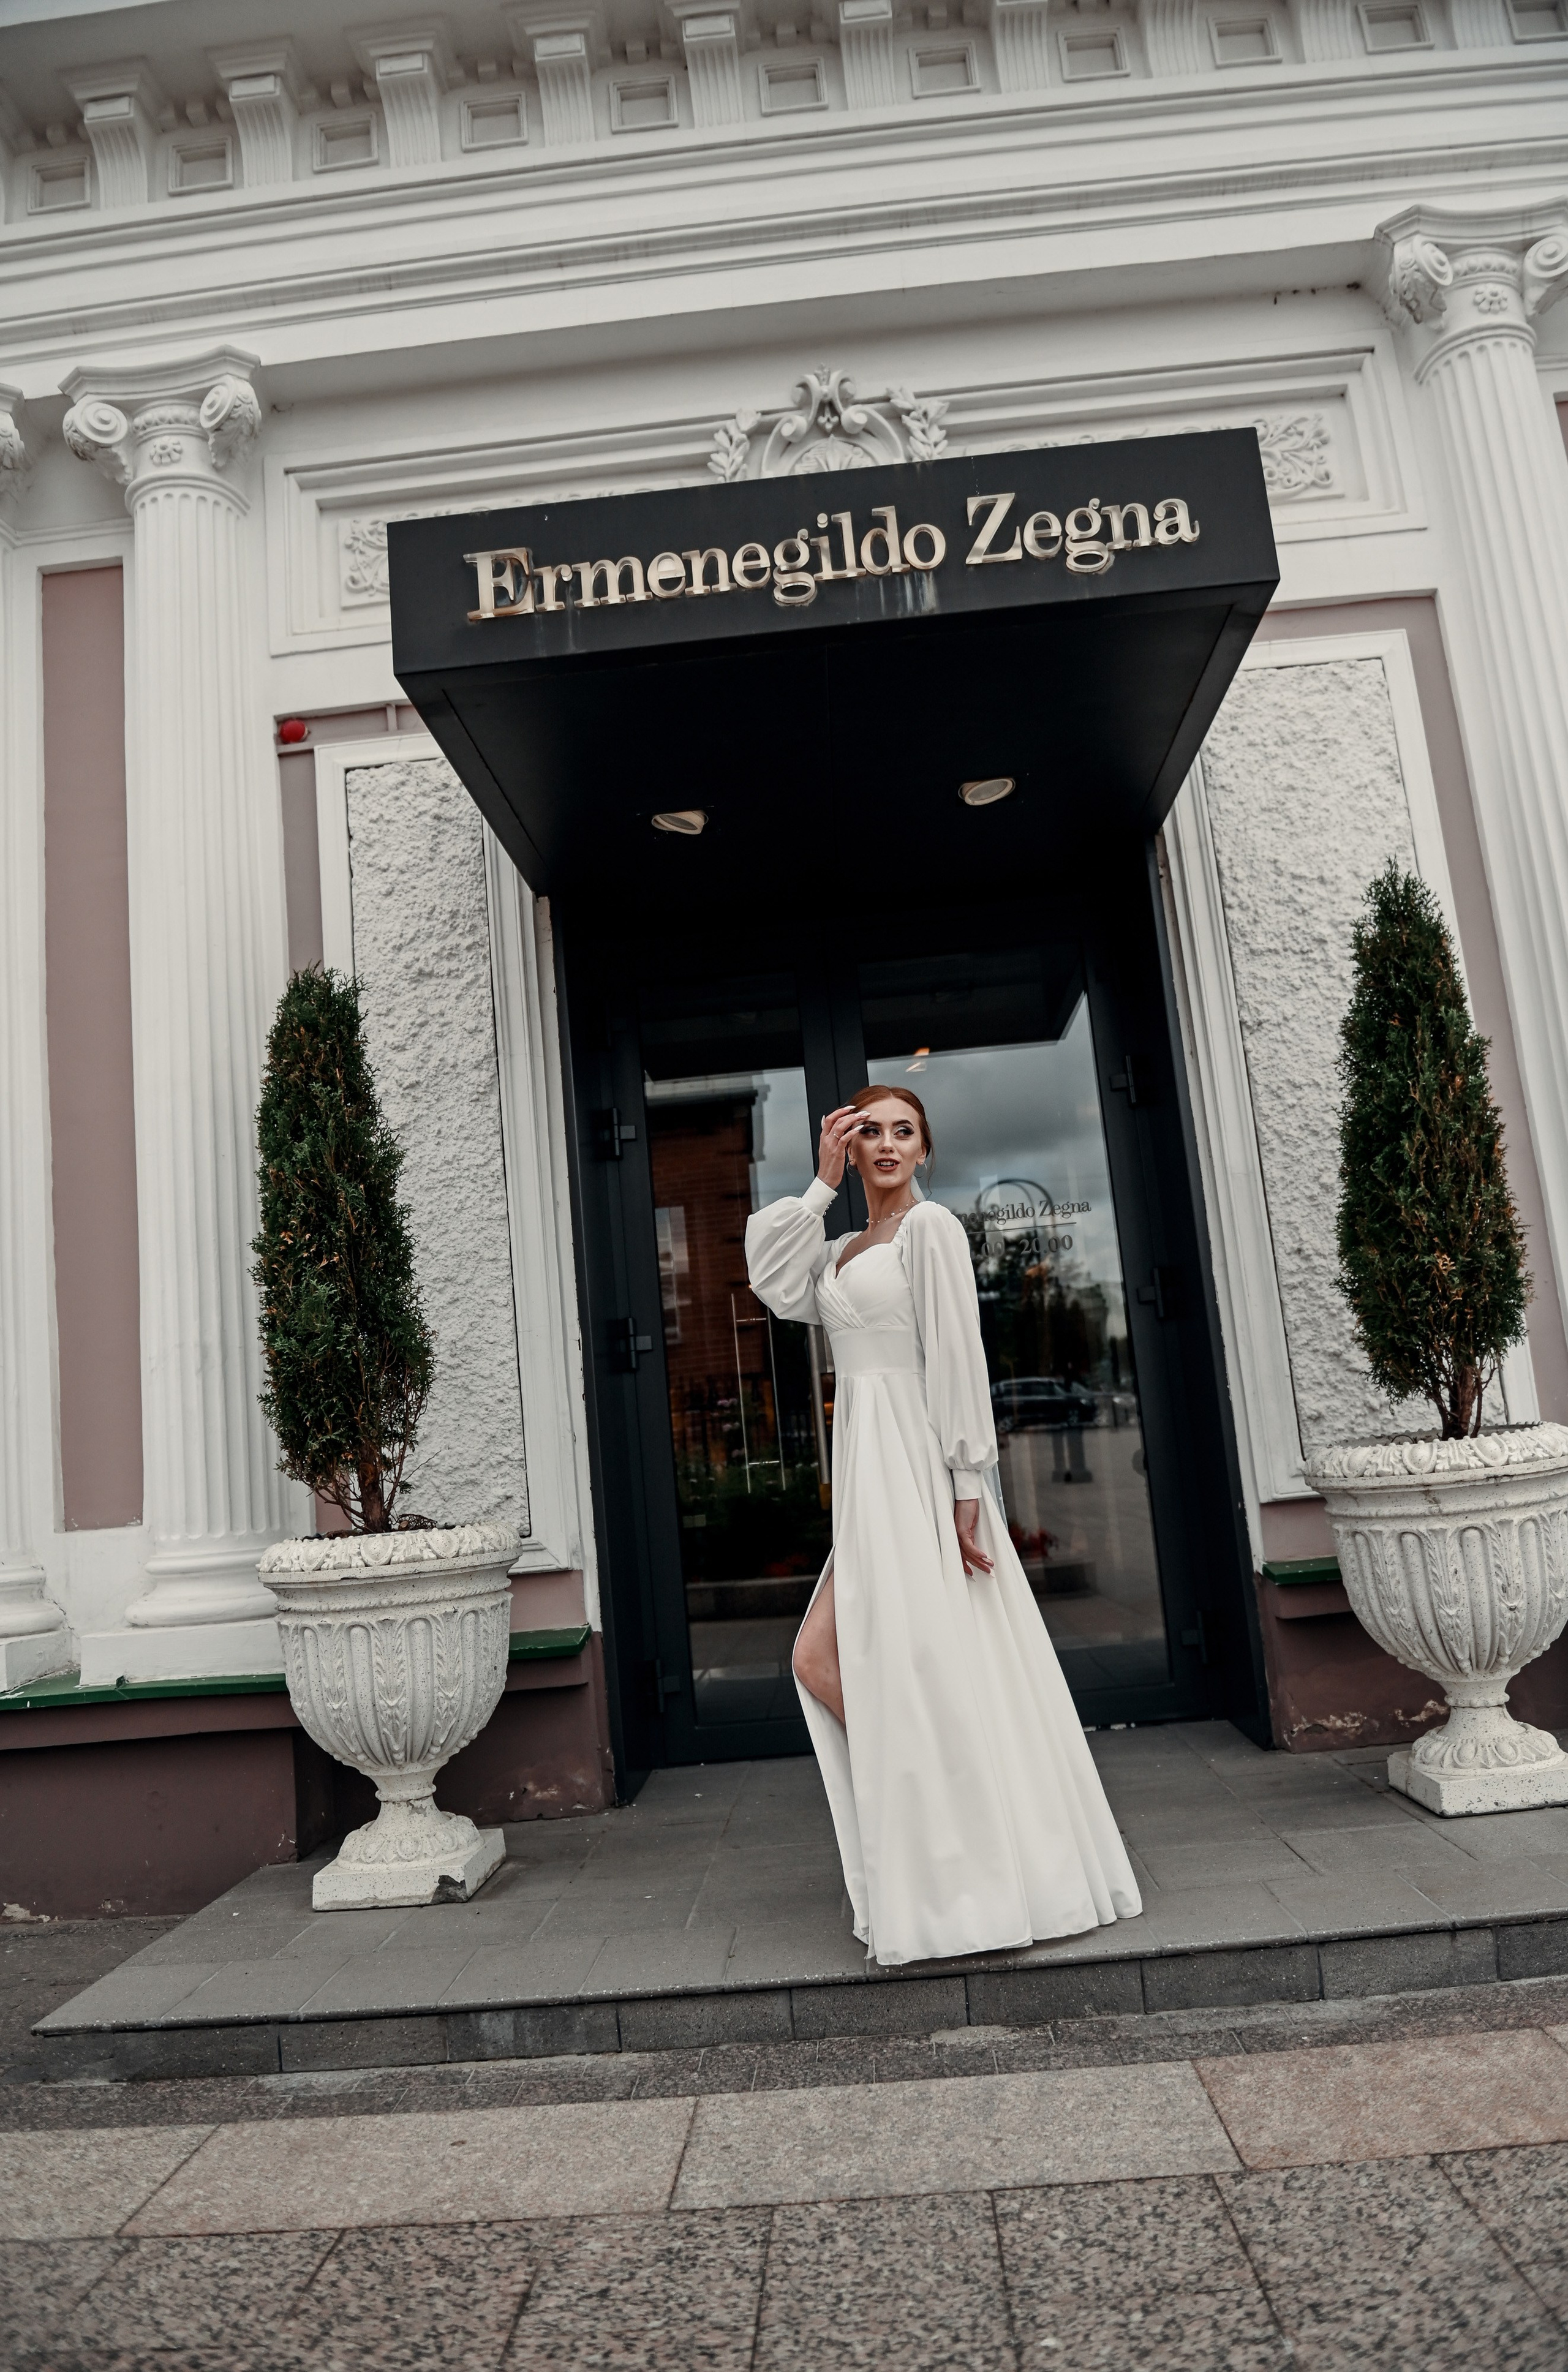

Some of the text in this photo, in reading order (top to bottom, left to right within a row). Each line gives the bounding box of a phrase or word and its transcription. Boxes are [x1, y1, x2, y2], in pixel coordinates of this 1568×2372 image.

[463, 492, 1200, 622] Ermenegildo Zegna
[1038, 1200, 1092, 1219] Zegna
[1019, 1234, 1073, 1255] 20.00
